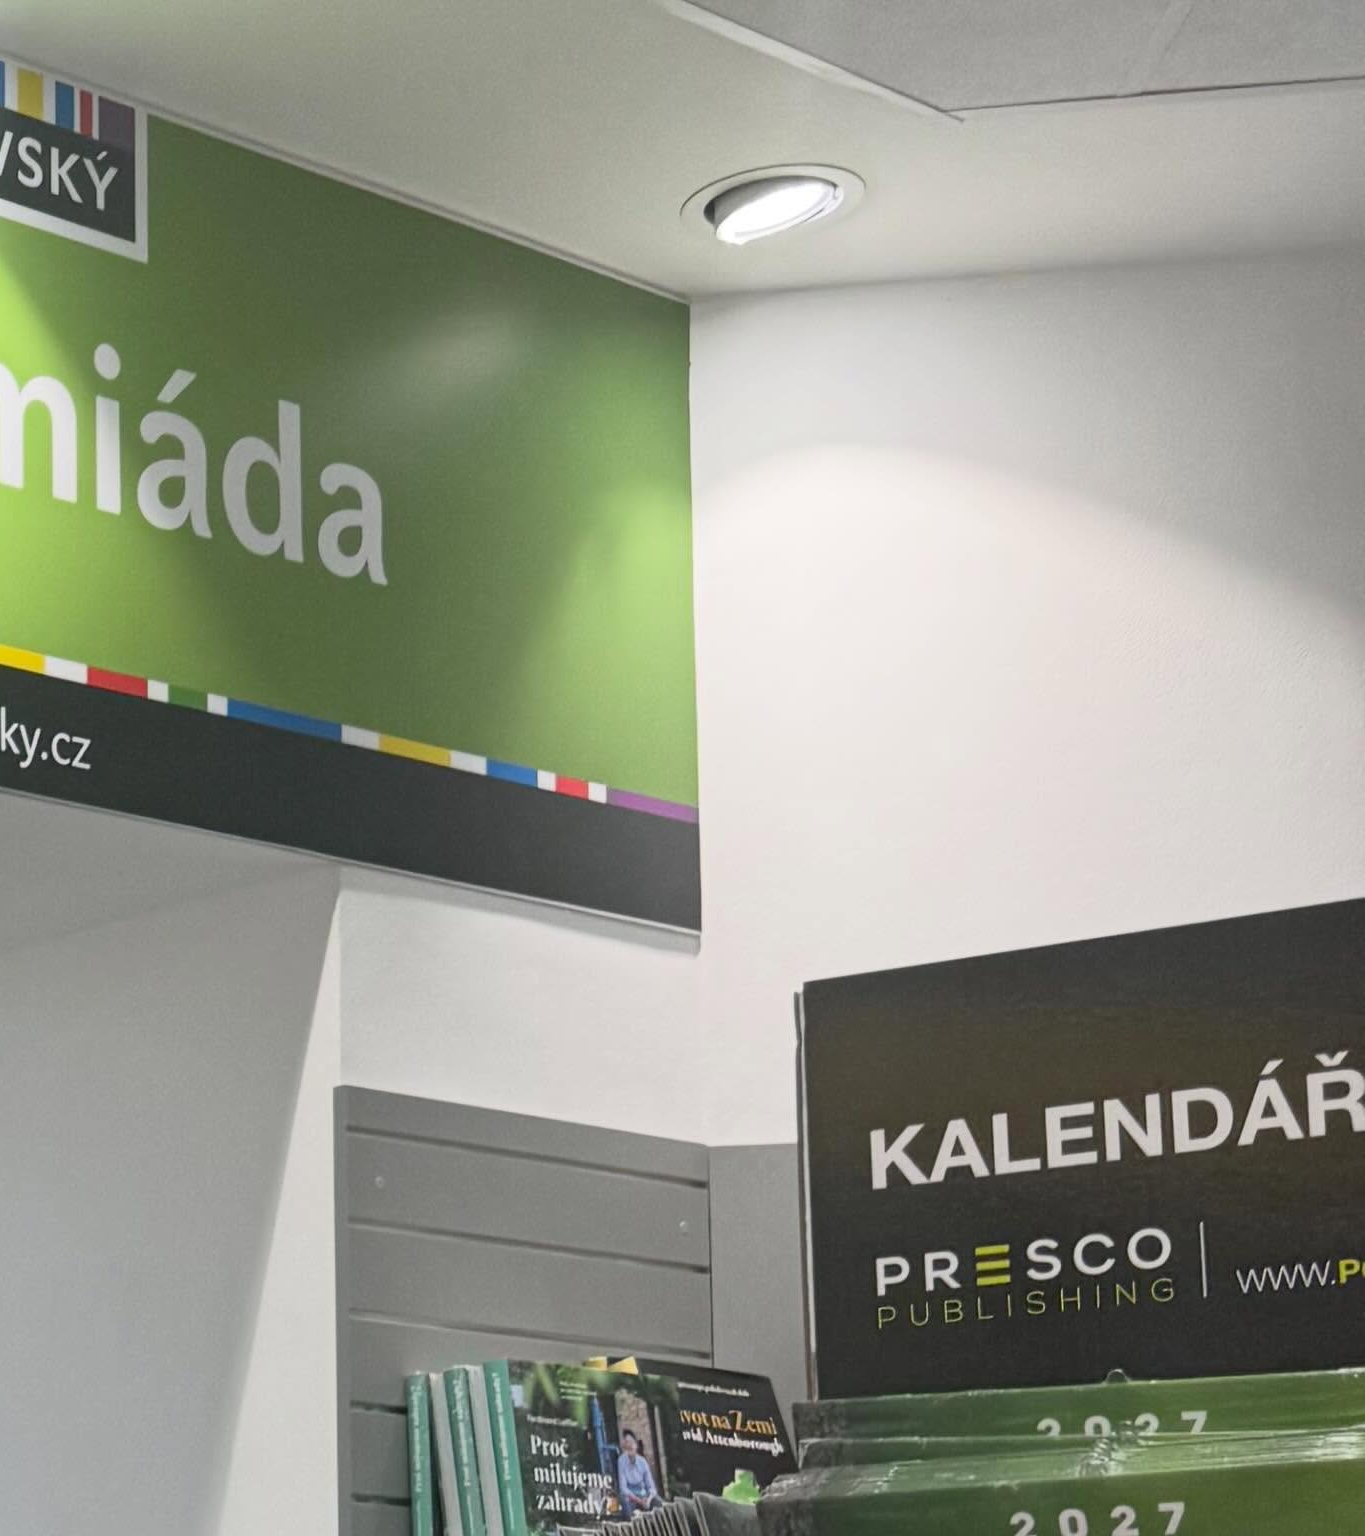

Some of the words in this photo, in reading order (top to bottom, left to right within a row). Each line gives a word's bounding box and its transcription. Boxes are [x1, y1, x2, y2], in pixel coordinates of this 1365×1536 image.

[870, 1050, 1365, 1190] KALENDÁŘ
[875, 1227, 1172, 1296] PRESCO
[1236, 1258, 1365, 1294] WWW.P
[878, 1277, 1174, 1329] PUBLISHING
[729, 1410, 778, 1435] Zemi
[530, 1434, 569, 1458] Proč
[534, 1462, 613, 1491] milujeme
